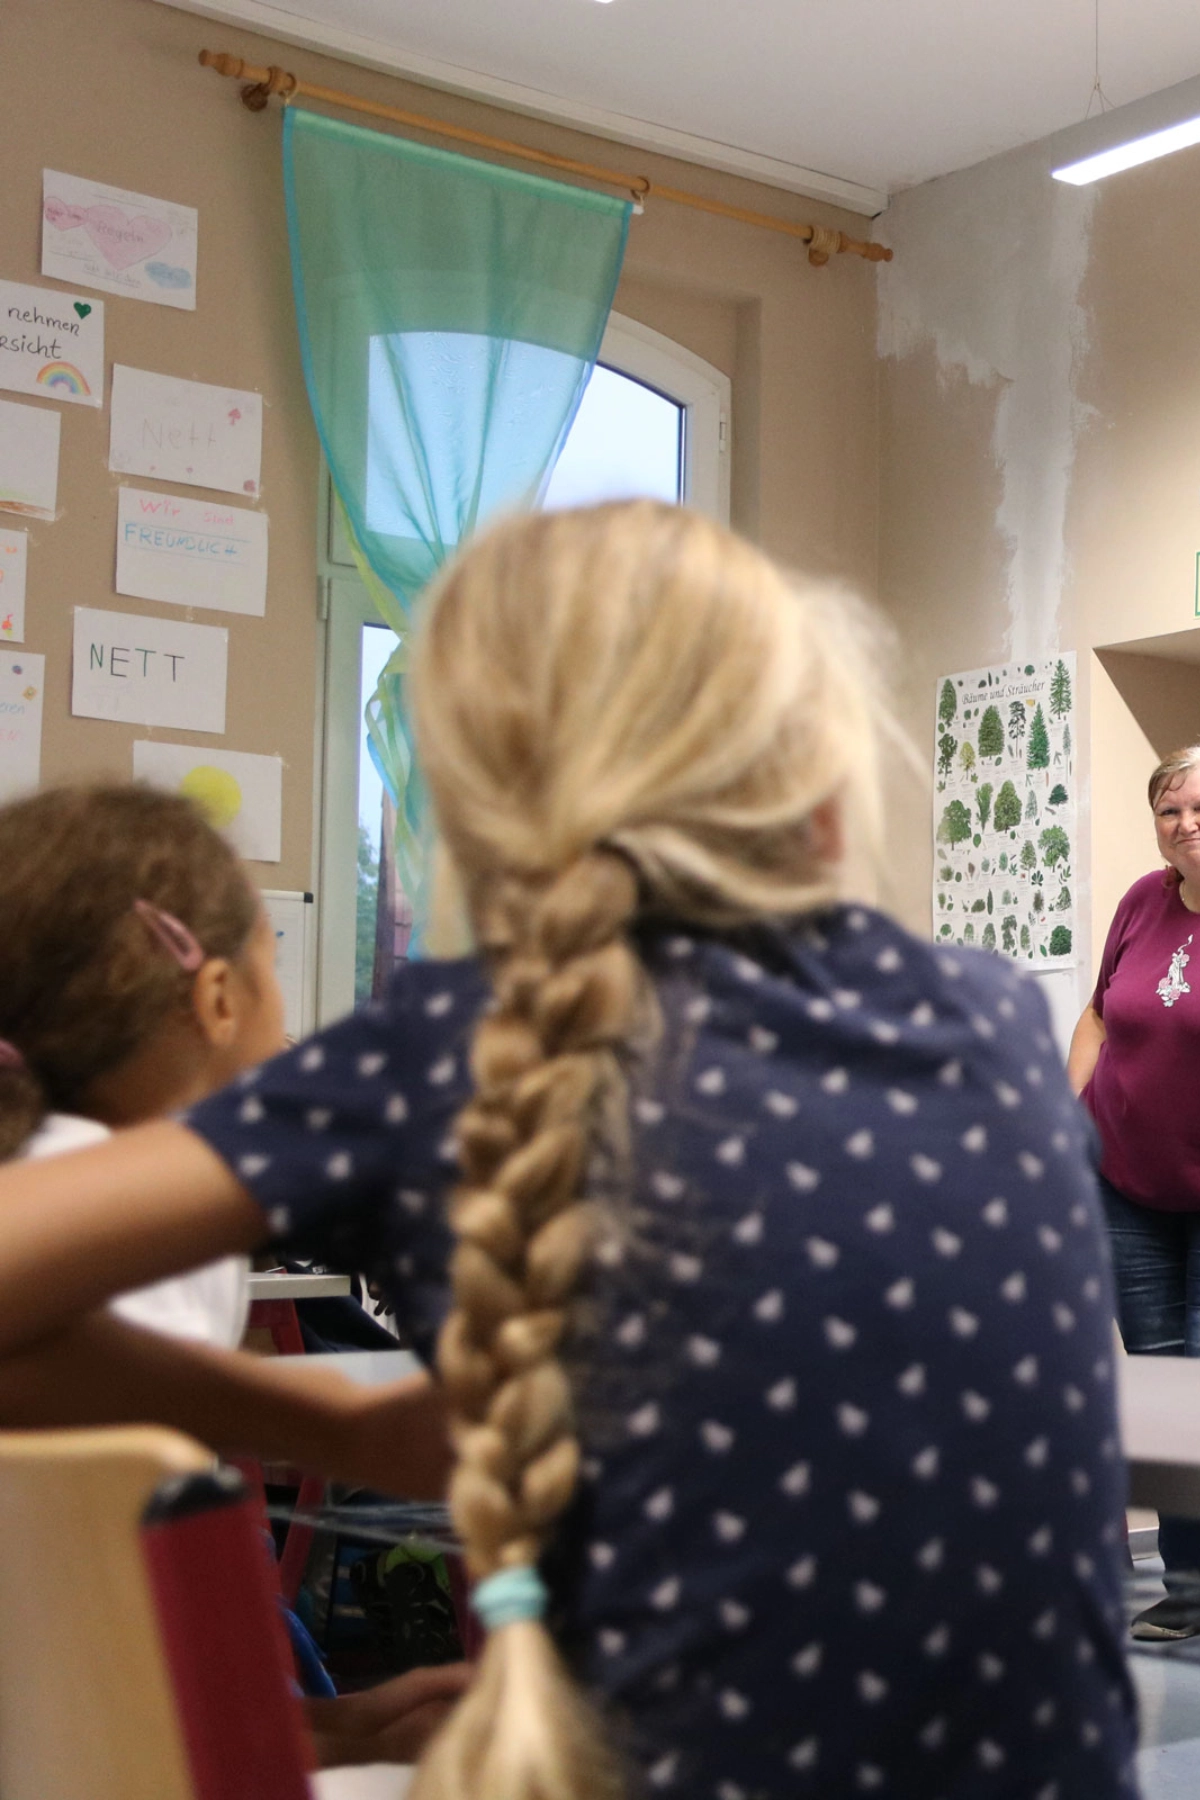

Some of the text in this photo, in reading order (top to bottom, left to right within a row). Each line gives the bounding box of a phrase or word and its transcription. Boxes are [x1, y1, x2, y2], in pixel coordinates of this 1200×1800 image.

[8, 306, 80, 337] nehmen
[140, 498, 180, 516] Wir
[90, 642, 185, 683] NETT
[962, 678, 1046, 705] Bäume und Sträucher
